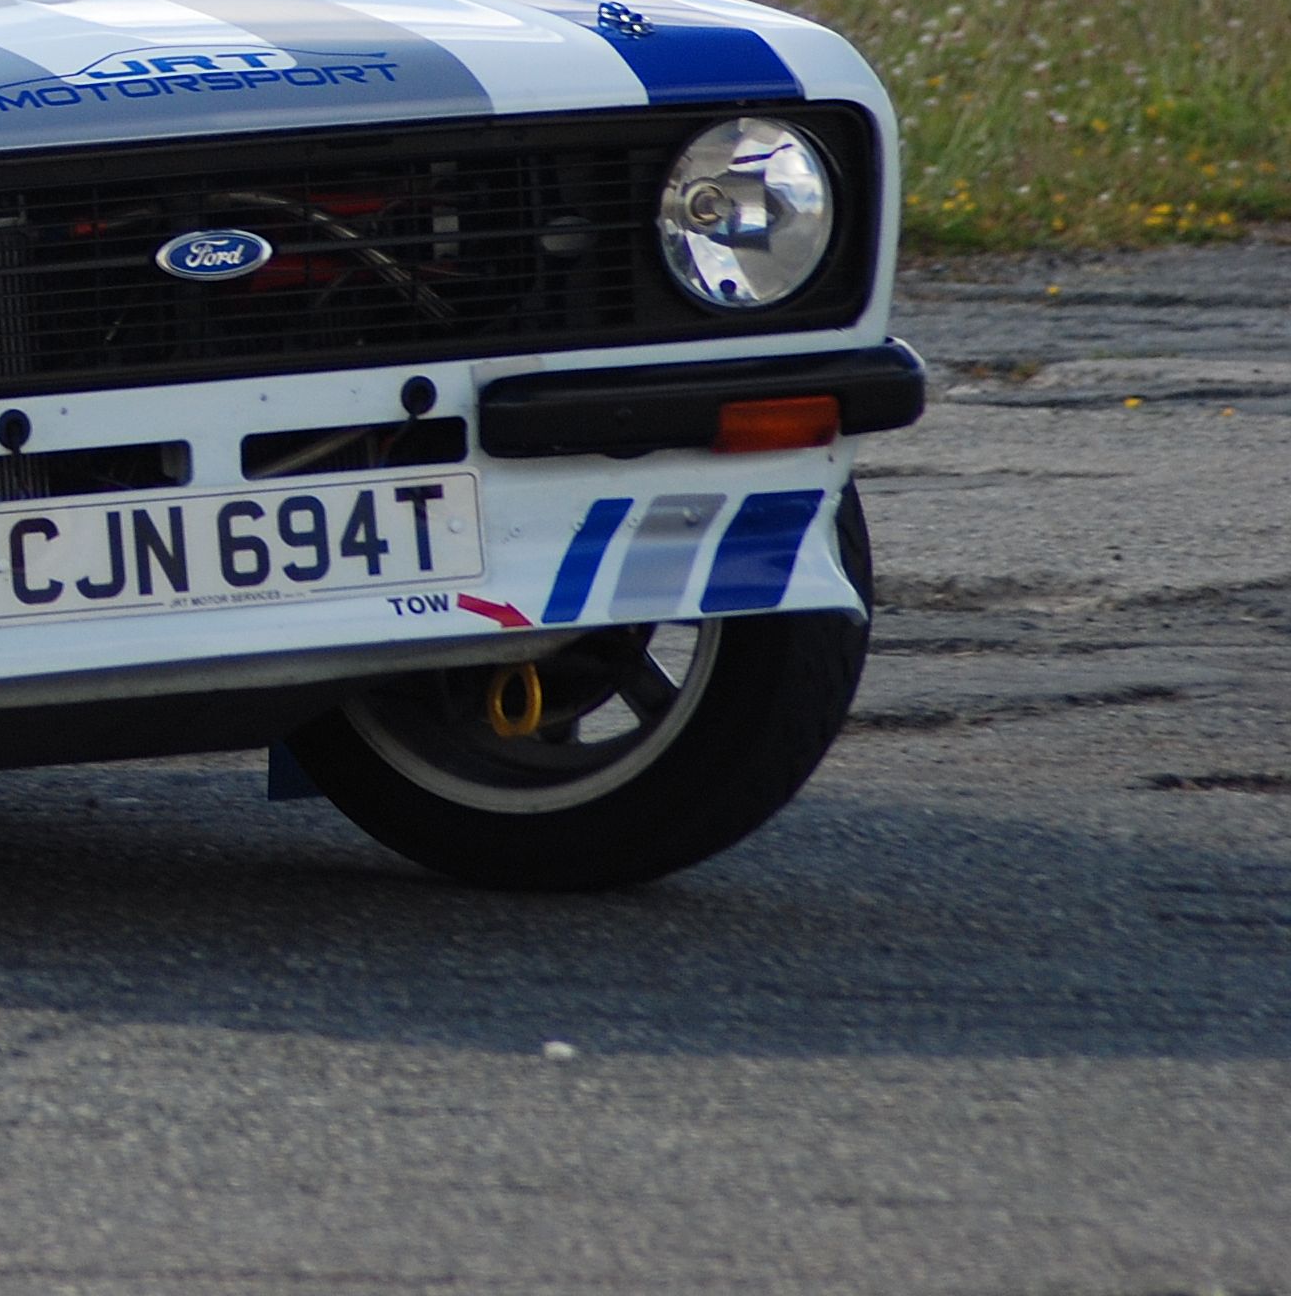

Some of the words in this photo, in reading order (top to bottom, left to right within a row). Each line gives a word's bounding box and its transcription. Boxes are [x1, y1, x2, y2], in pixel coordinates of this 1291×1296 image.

[86, 52, 277, 80] JRT
[185, 238, 245, 268] Ford
[8, 505, 191, 605] CJN
[218, 484, 445, 589] 694T
[386, 594, 451, 617] TOW
